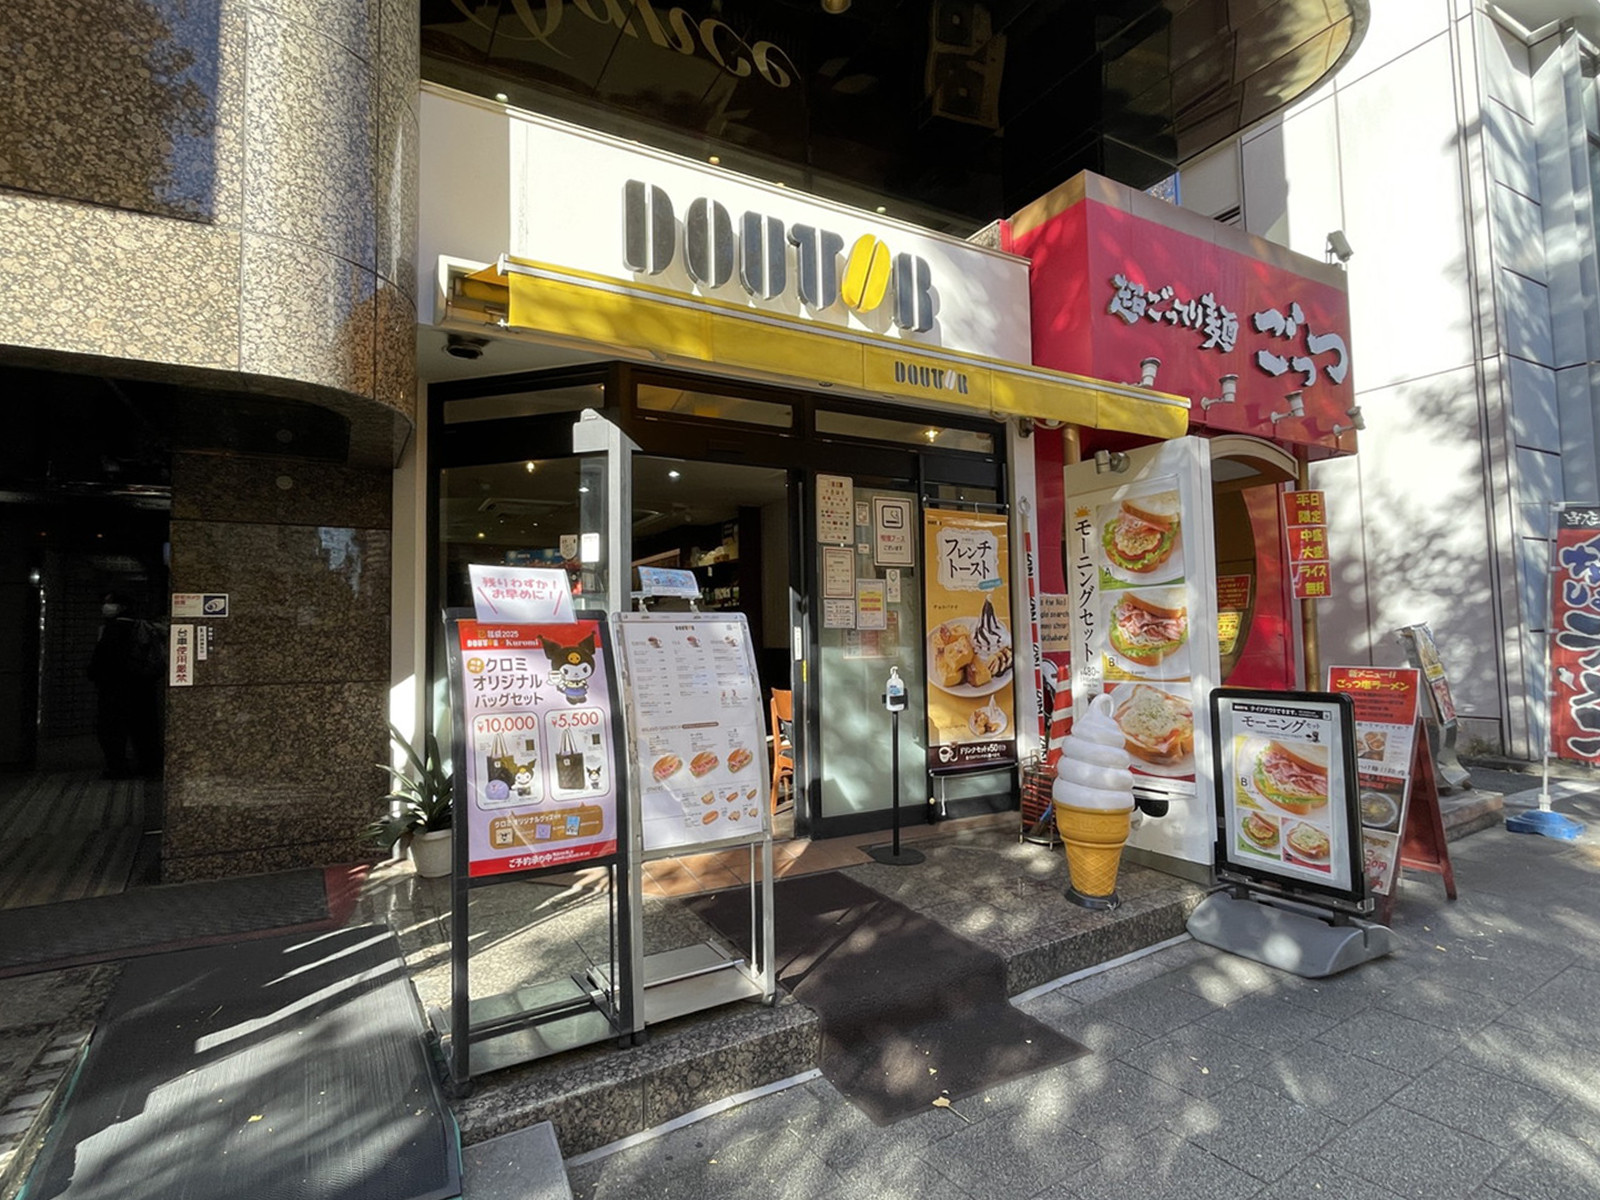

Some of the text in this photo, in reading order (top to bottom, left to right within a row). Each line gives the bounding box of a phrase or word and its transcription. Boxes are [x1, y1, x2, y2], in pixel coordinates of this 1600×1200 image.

[622, 179, 935, 333] DOUTOR
[1108, 273, 1240, 353] 超ごってり麺
[1252, 302, 1349, 387] ごっつ
[894, 360, 969, 395] DOUTOR
[1296, 493, 1320, 507] 平日
[1298, 510, 1322, 523] 限定
[1300, 528, 1323, 542] 中盛
[944, 538, 992, 560] フレンチ
[1302, 546, 1324, 559] 大盛
[949, 558, 990, 580] トースト
[1104, 567, 1112, 577] A
[1300, 564, 1327, 578] ライス
[1074, 518, 1095, 663] モーニングセット
[1305, 582, 1326, 595] 無料
[505, 638, 539, 647] Kuromi
[176, 628, 188, 683] 台車使用厳禁
[1108, 657, 1116, 667] B
[486, 657, 528, 673] クロミ
[473, 674, 543, 691] オリジナル
[1335, 679, 1410, 691] ごっつ塩ラーメン
[474, 692, 544, 708] バッグセット
[477, 715, 535, 733] ¥10,000
[551, 711, 599, 728] ¥5,500
[1240, 777, 1249, 787] B
